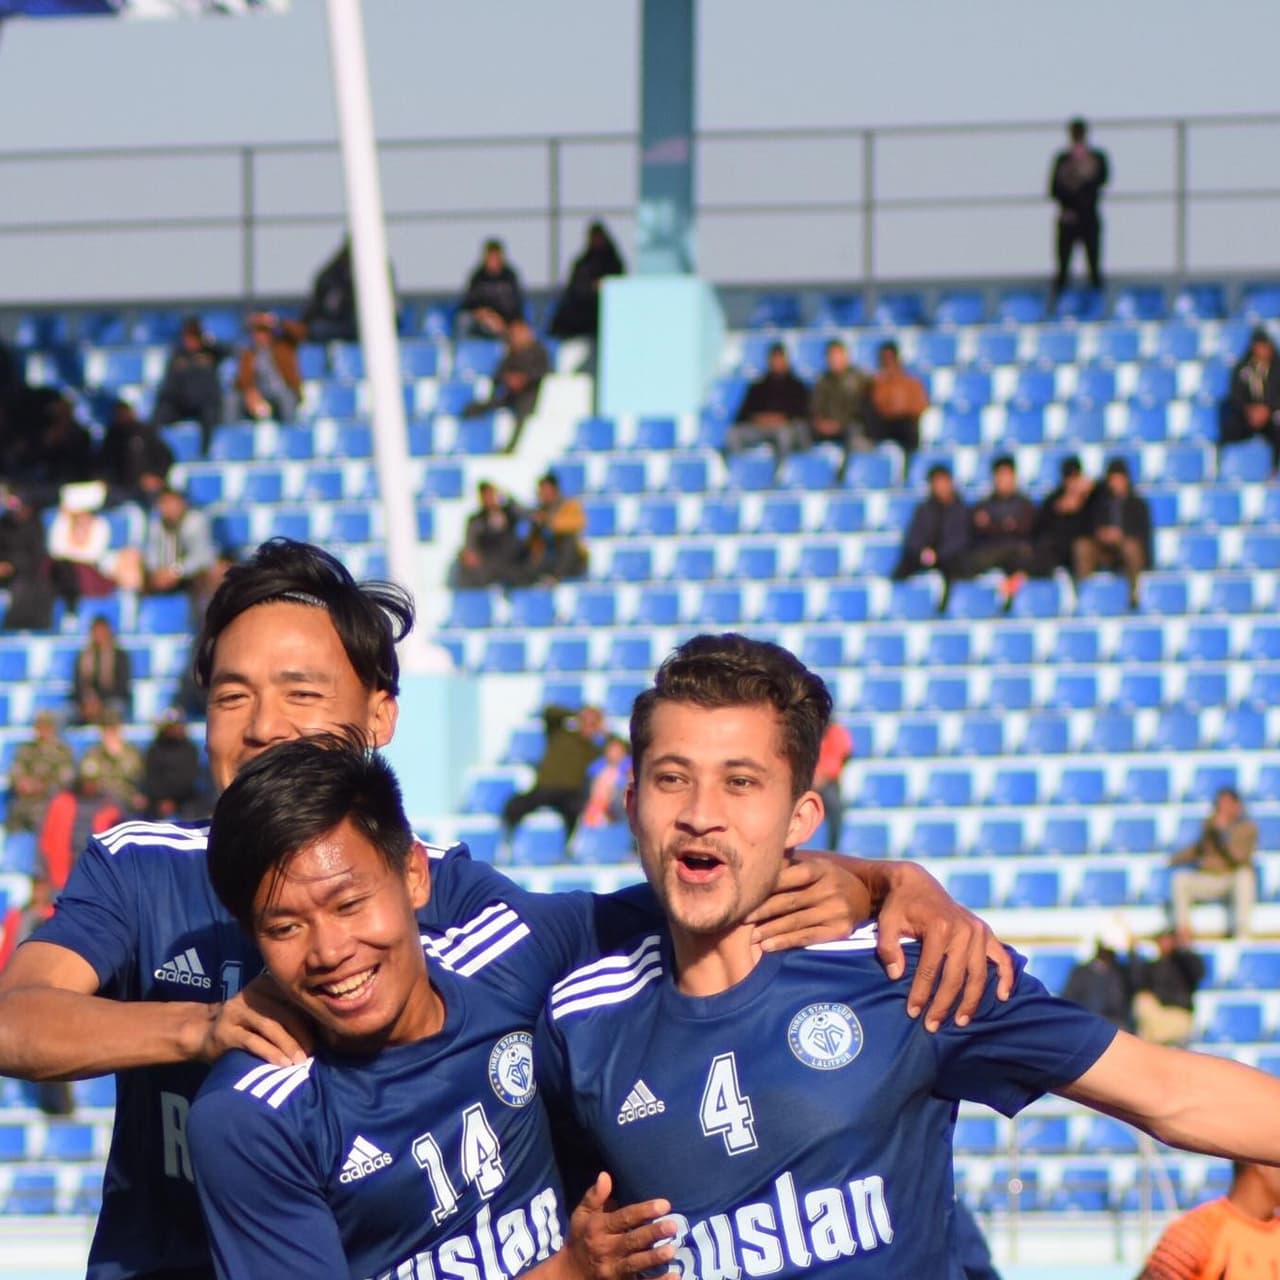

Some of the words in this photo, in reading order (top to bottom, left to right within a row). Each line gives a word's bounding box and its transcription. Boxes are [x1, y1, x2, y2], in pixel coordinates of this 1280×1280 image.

[154, 967, 212, 989] adidas
[616, 1100, 666, 1126] adidas
[699, 1051, 759, 1157] 4
[339, 1151, 394, 1184] adidas
[412, 1102, 506, 1226] 14
